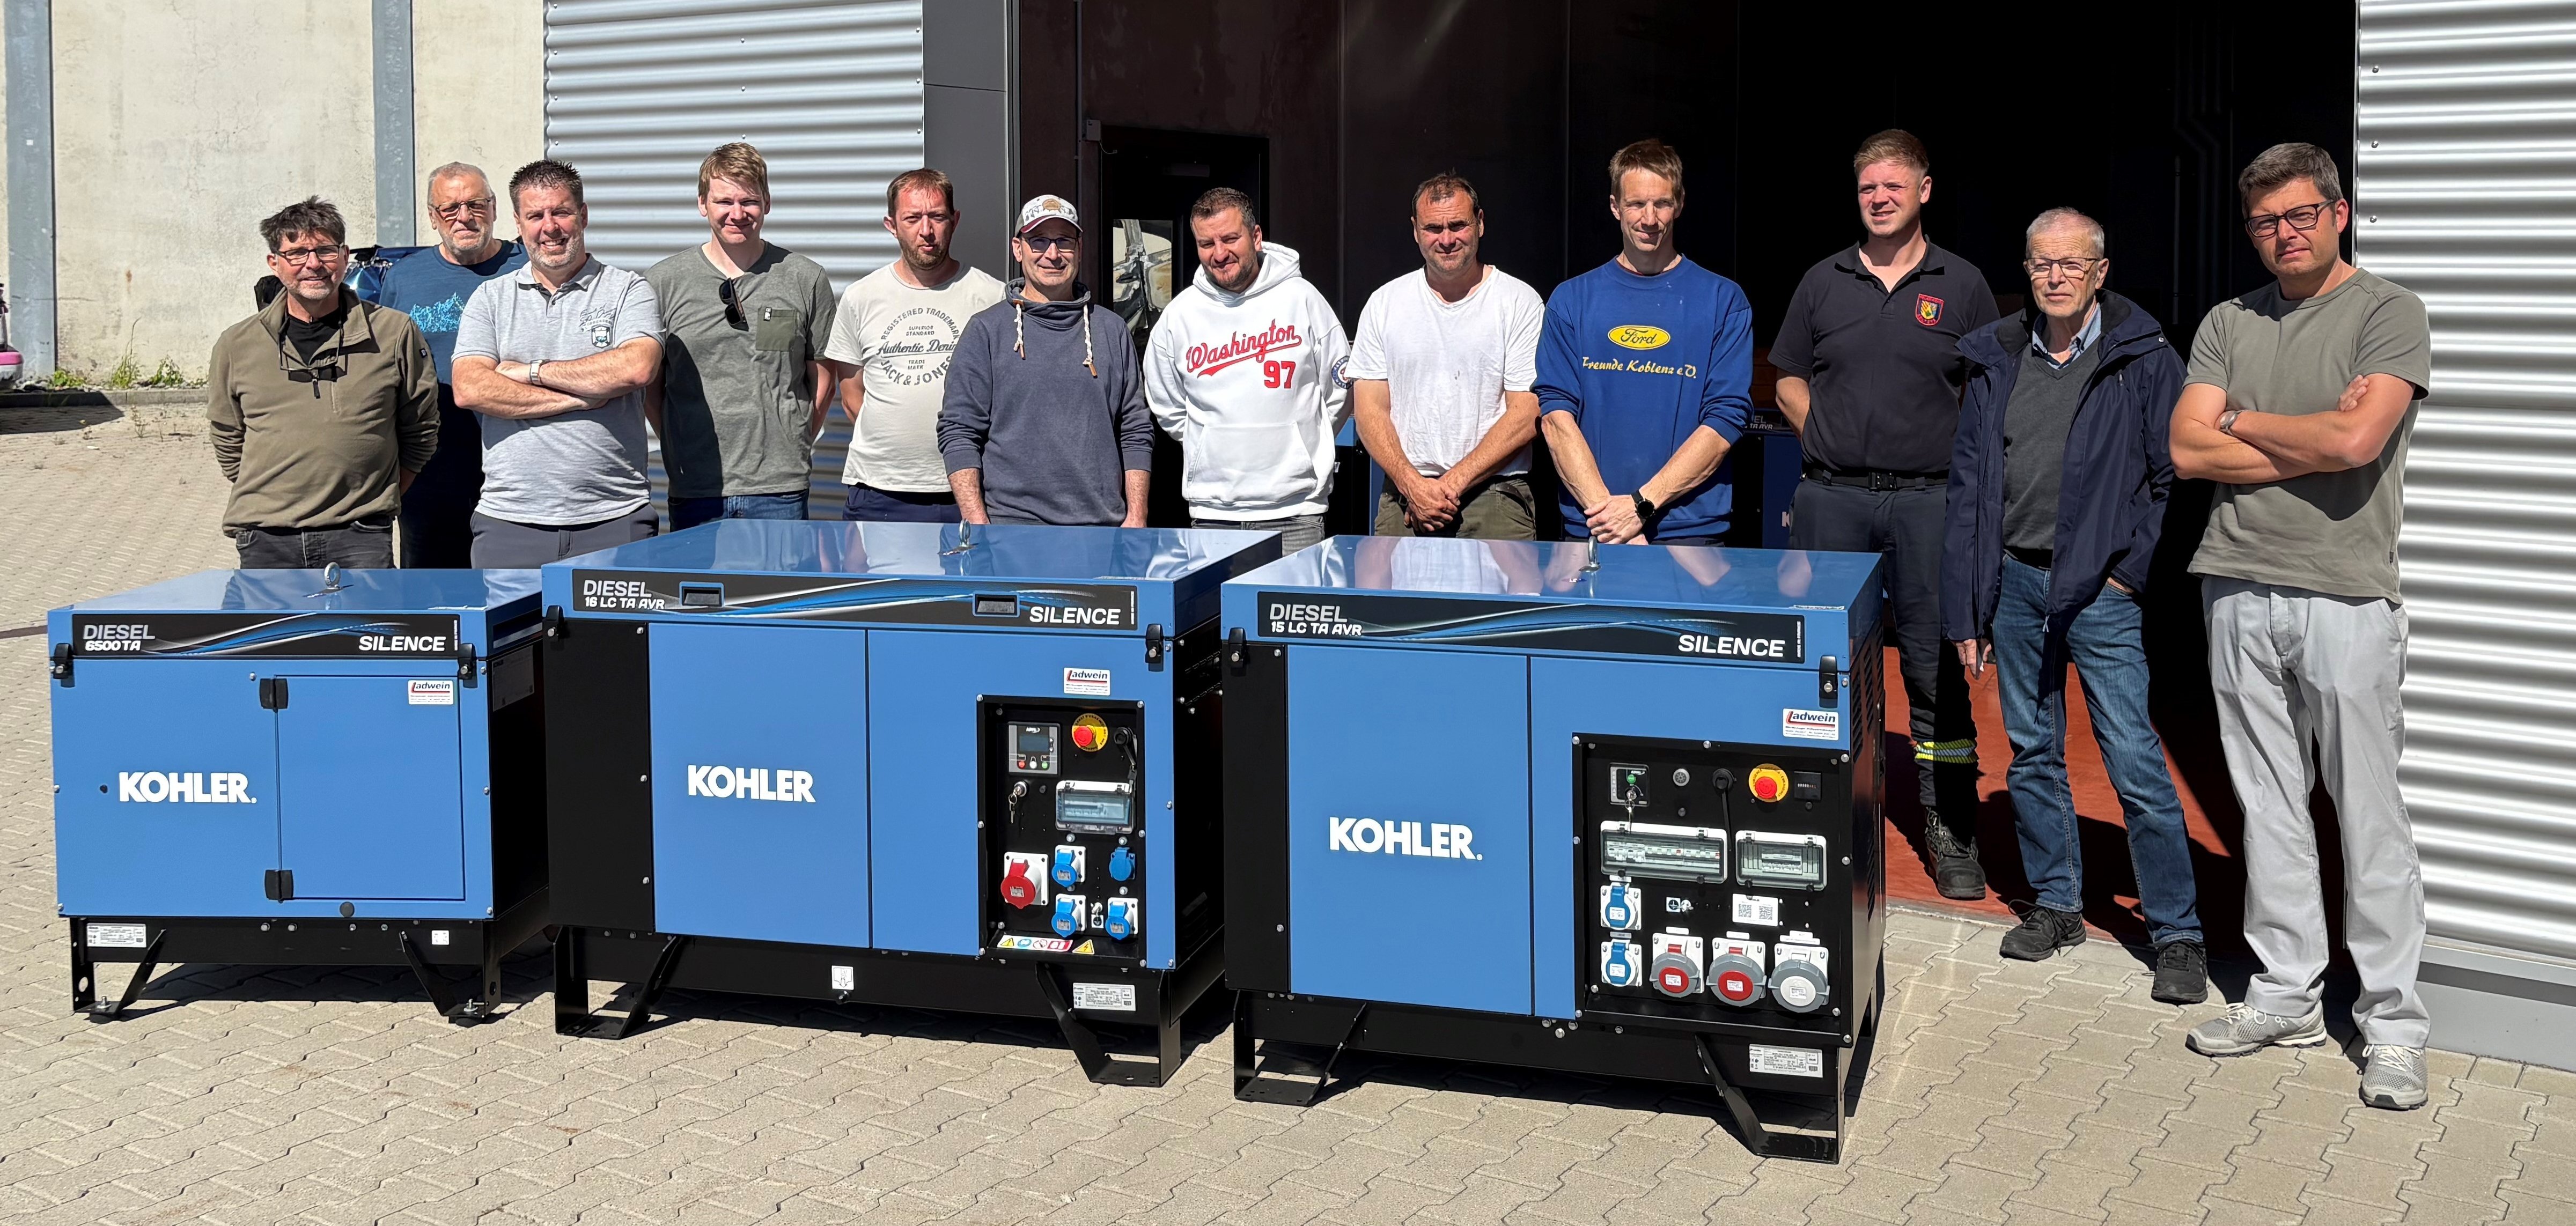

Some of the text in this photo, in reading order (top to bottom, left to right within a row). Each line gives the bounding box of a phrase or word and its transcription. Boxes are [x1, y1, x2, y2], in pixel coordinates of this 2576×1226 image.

[881, 307, 960, 340] REGISTERED TRADEMARK
[1621, 328, 1657, 344] Ford
[876, 341, 924, 355] Authentic
[1186, 319, 1302, 373] Washington
[881, 360, 904, 385] JACK
[1583, 357, 1623, 371] Freunde
[1626, 360, 1674, 374] Koblenz
[1264, 360, 1296, 389] 97
[584, 580, 652, 597] DIESEL
[585, 597, 665, 609] 16 LC TA AVR
[1029, 607, 1121, 625] SILENCE
[1270, 603, 1348, 623] DIESEL
[83, 625, 156, 640] DIESEL
[1271, 621, 1363, 636] 15 LC TA AVR
[358, 636, 446, 651] SILENCE
[1678, 634, 1785, 657] SILENCE
[1066, 670, 1108, 682] Ladwein
[1786, 711, 1836, 724] Ladwein
[688, 765, 816, 802] KOHLER
